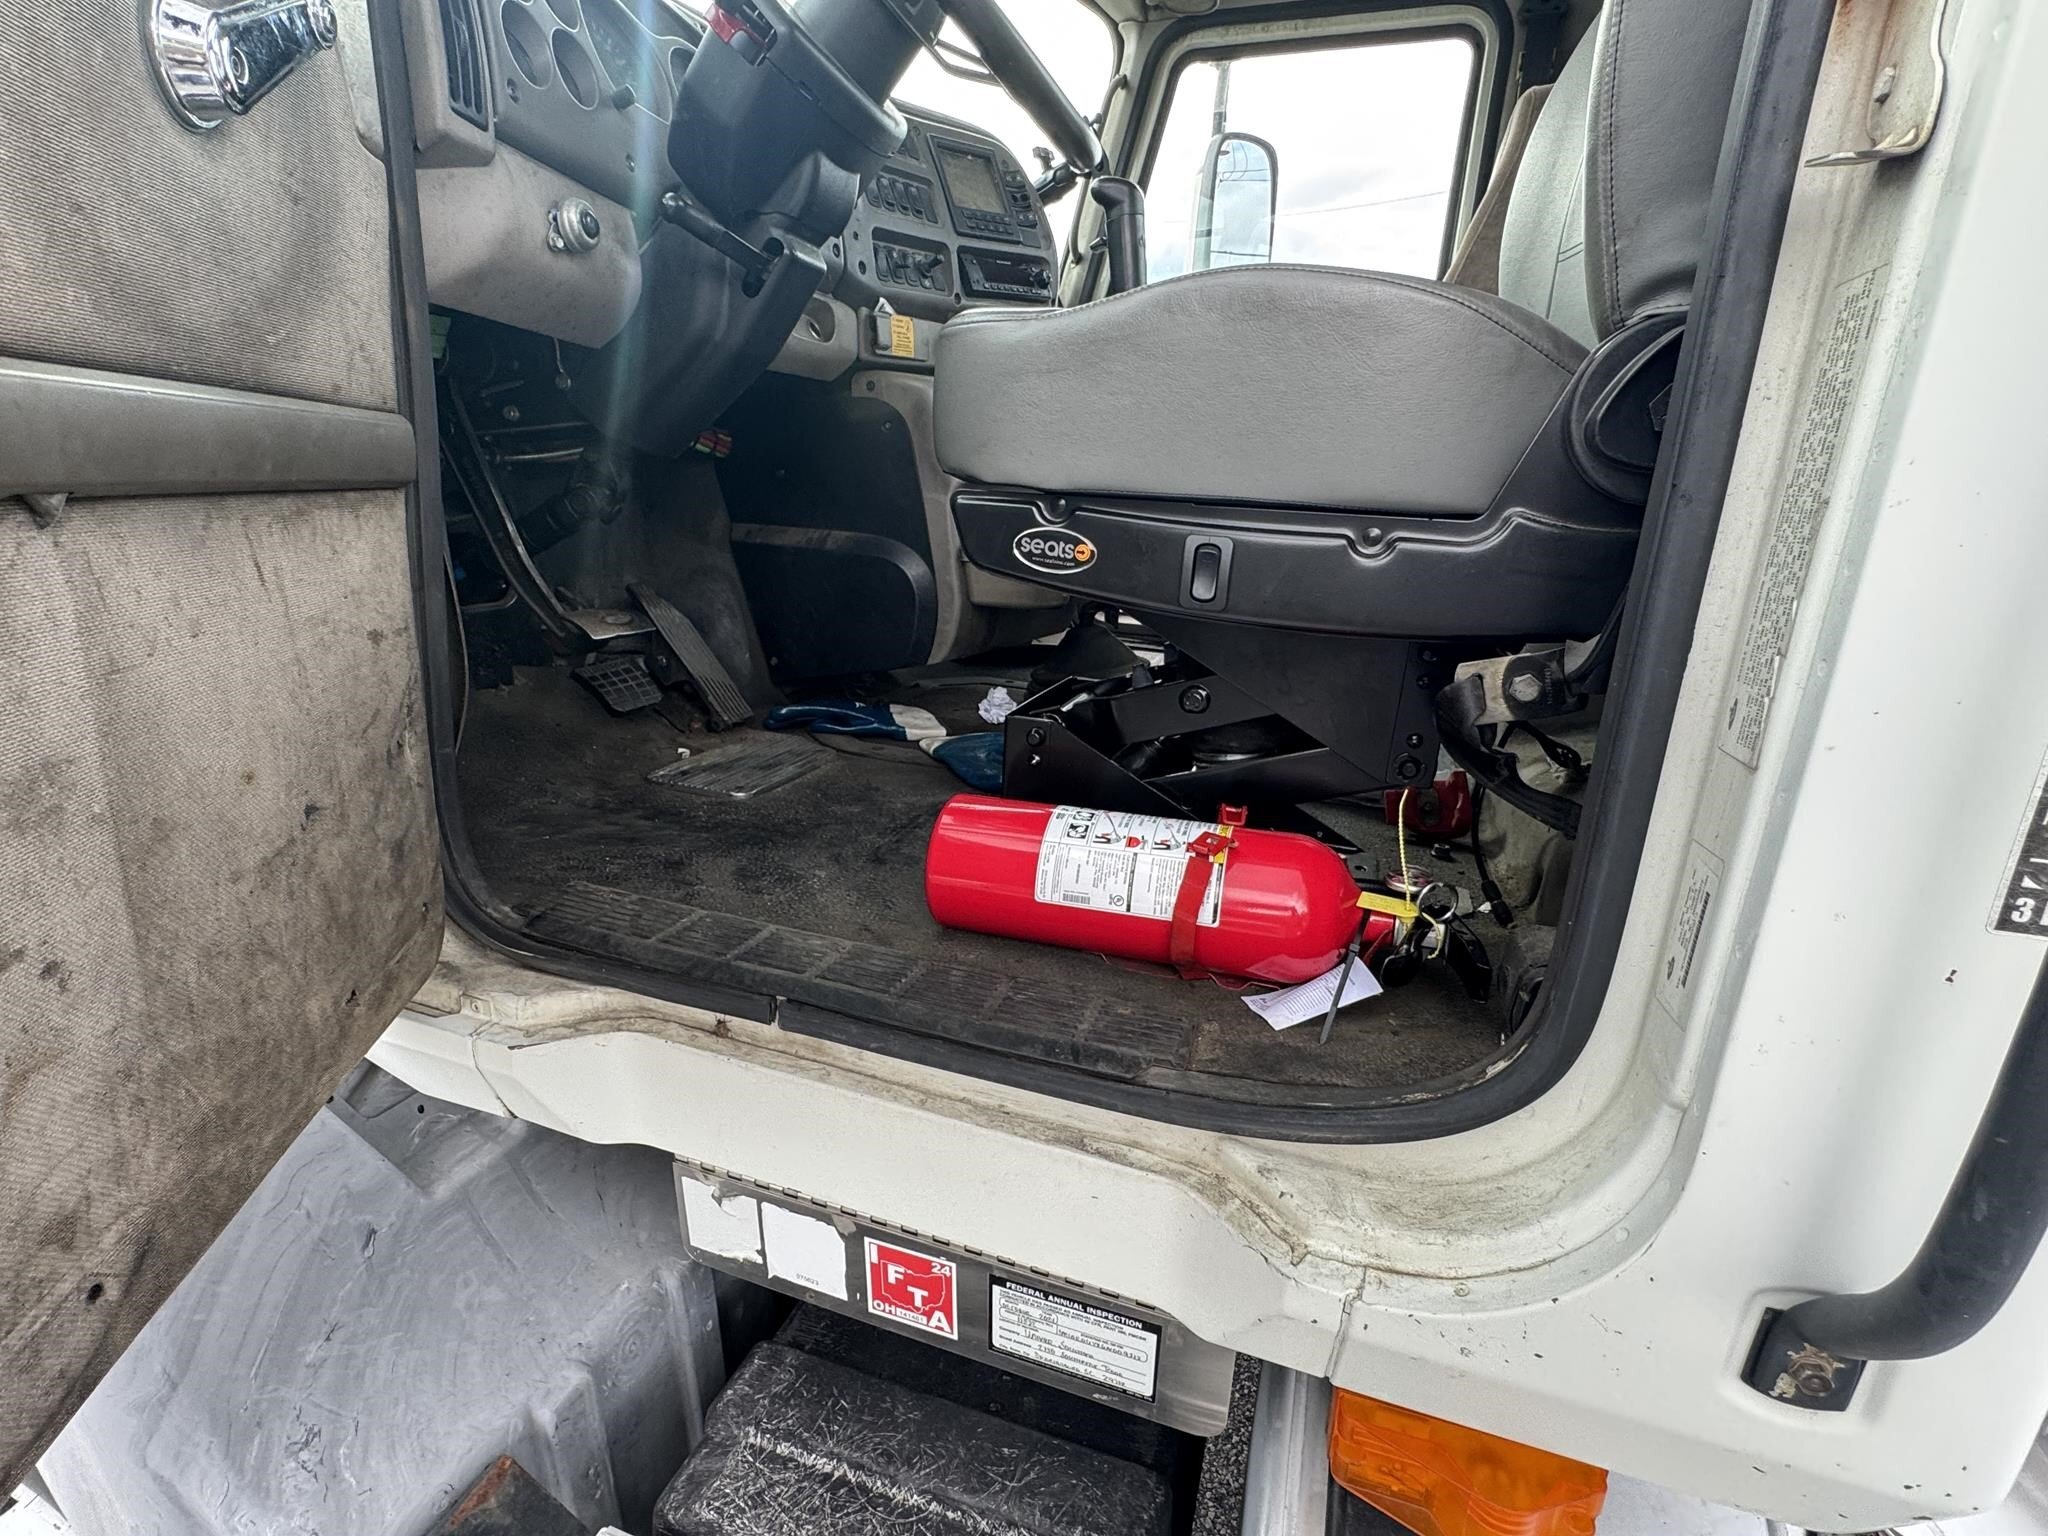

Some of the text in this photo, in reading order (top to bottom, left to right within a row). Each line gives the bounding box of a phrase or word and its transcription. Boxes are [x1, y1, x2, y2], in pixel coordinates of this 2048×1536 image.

[1020, 537, 1075, 559] seats
[931, 1262, 952, 1278] 24
[887, 1264, 905, 1284] F
[907, 1286, 928, 1308] T
[928, 1310, 952, 1333] A
[1006, 1282, 1045, 1299] FEDERAL
[1047, 1294, 1084, 1311] ANNUAL
[1086, 1306, 1143, 1329] INSPECTION
